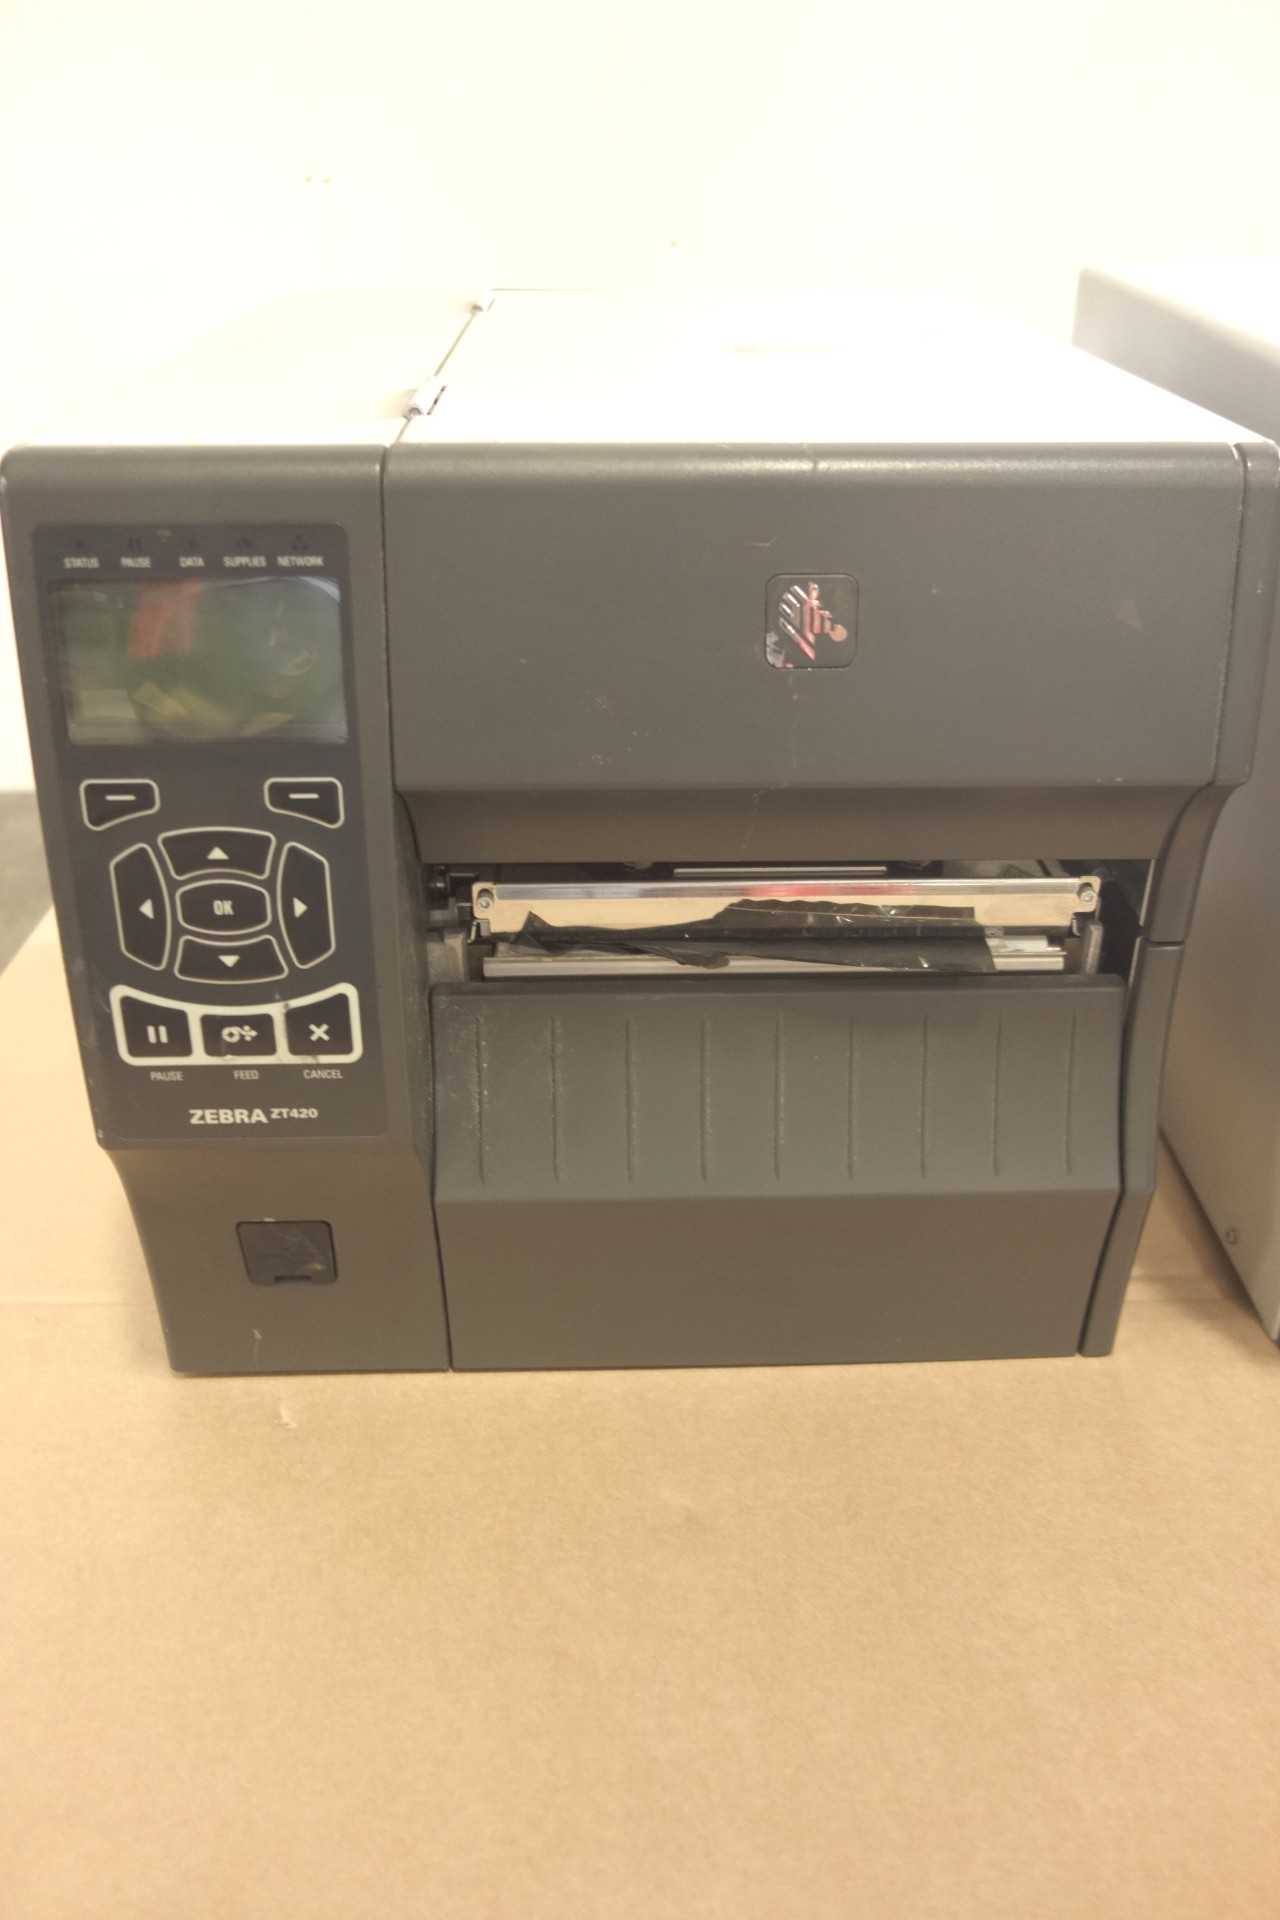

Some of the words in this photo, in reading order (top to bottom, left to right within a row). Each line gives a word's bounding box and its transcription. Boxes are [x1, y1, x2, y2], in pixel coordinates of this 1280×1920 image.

[63, 556, 99, 569] STATUS
[121, 556, 151, 568] PAUSE
[179, 556, 204, 568] DATA
[223, 556, 267, 568] SUPPLIES
[277, 556, 324, 567] NETWORK
[213, 899, 234, 915] OK
[150, 1071, 183, 1081] PAUSE
[234, 1069, 259, 1080] FEED
[303, 1069, 343, 1079] CANCEL
[189, 1108, 268, 1125] ZEBRA
[270, 1107, 318, 1119] ZT420
